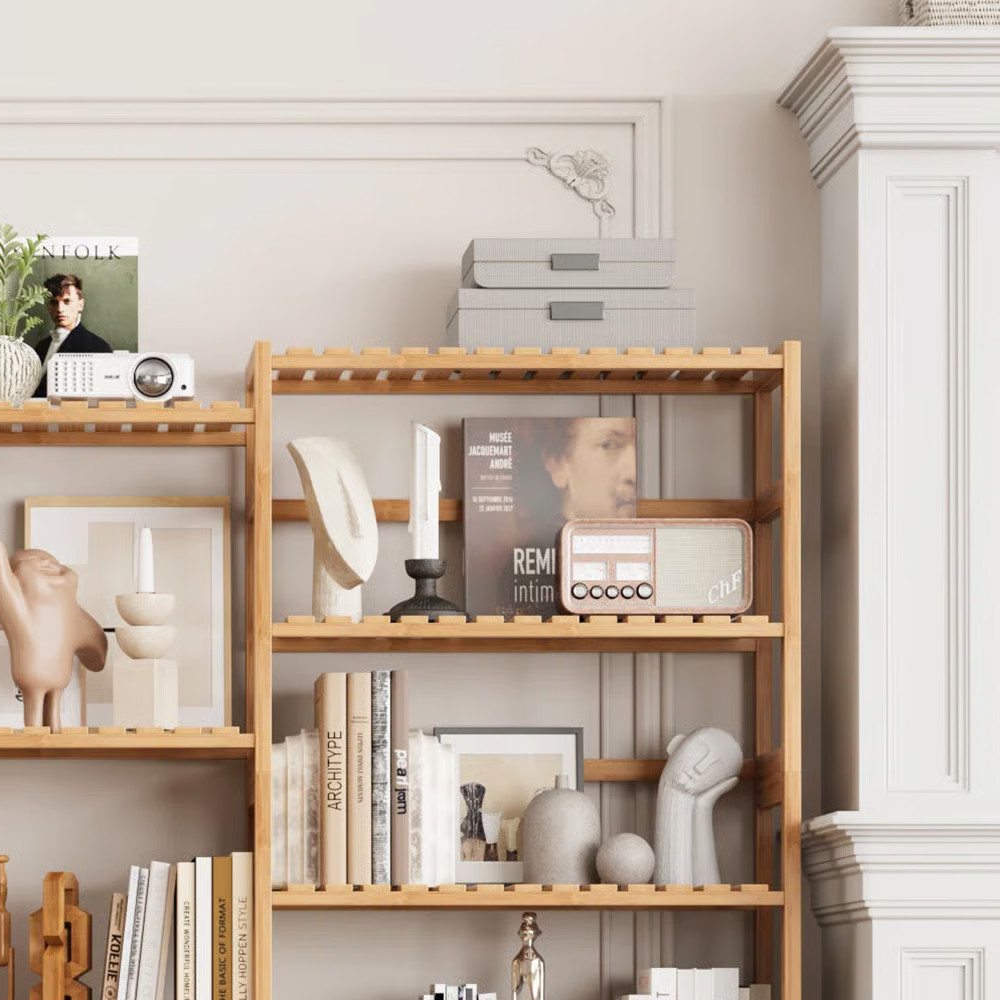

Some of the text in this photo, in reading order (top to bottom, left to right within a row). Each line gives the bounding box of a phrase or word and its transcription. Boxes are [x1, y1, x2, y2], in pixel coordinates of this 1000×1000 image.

[41, 244, 121, 261] NFOLK
[489, 431, 512, 443] MUSÉE
[468, 445, 512, 456] JACQUEMART
[489, 457, 512, 469] ANDRÉ
[327, 731, 342, 811] ARCHITYPE
[394, 750, 408, 785] pearl
[239, 897, 248, 930] STYLE
[219, 943, 226, 955] OF
[238, 933, 248, 977] HOPPEN
